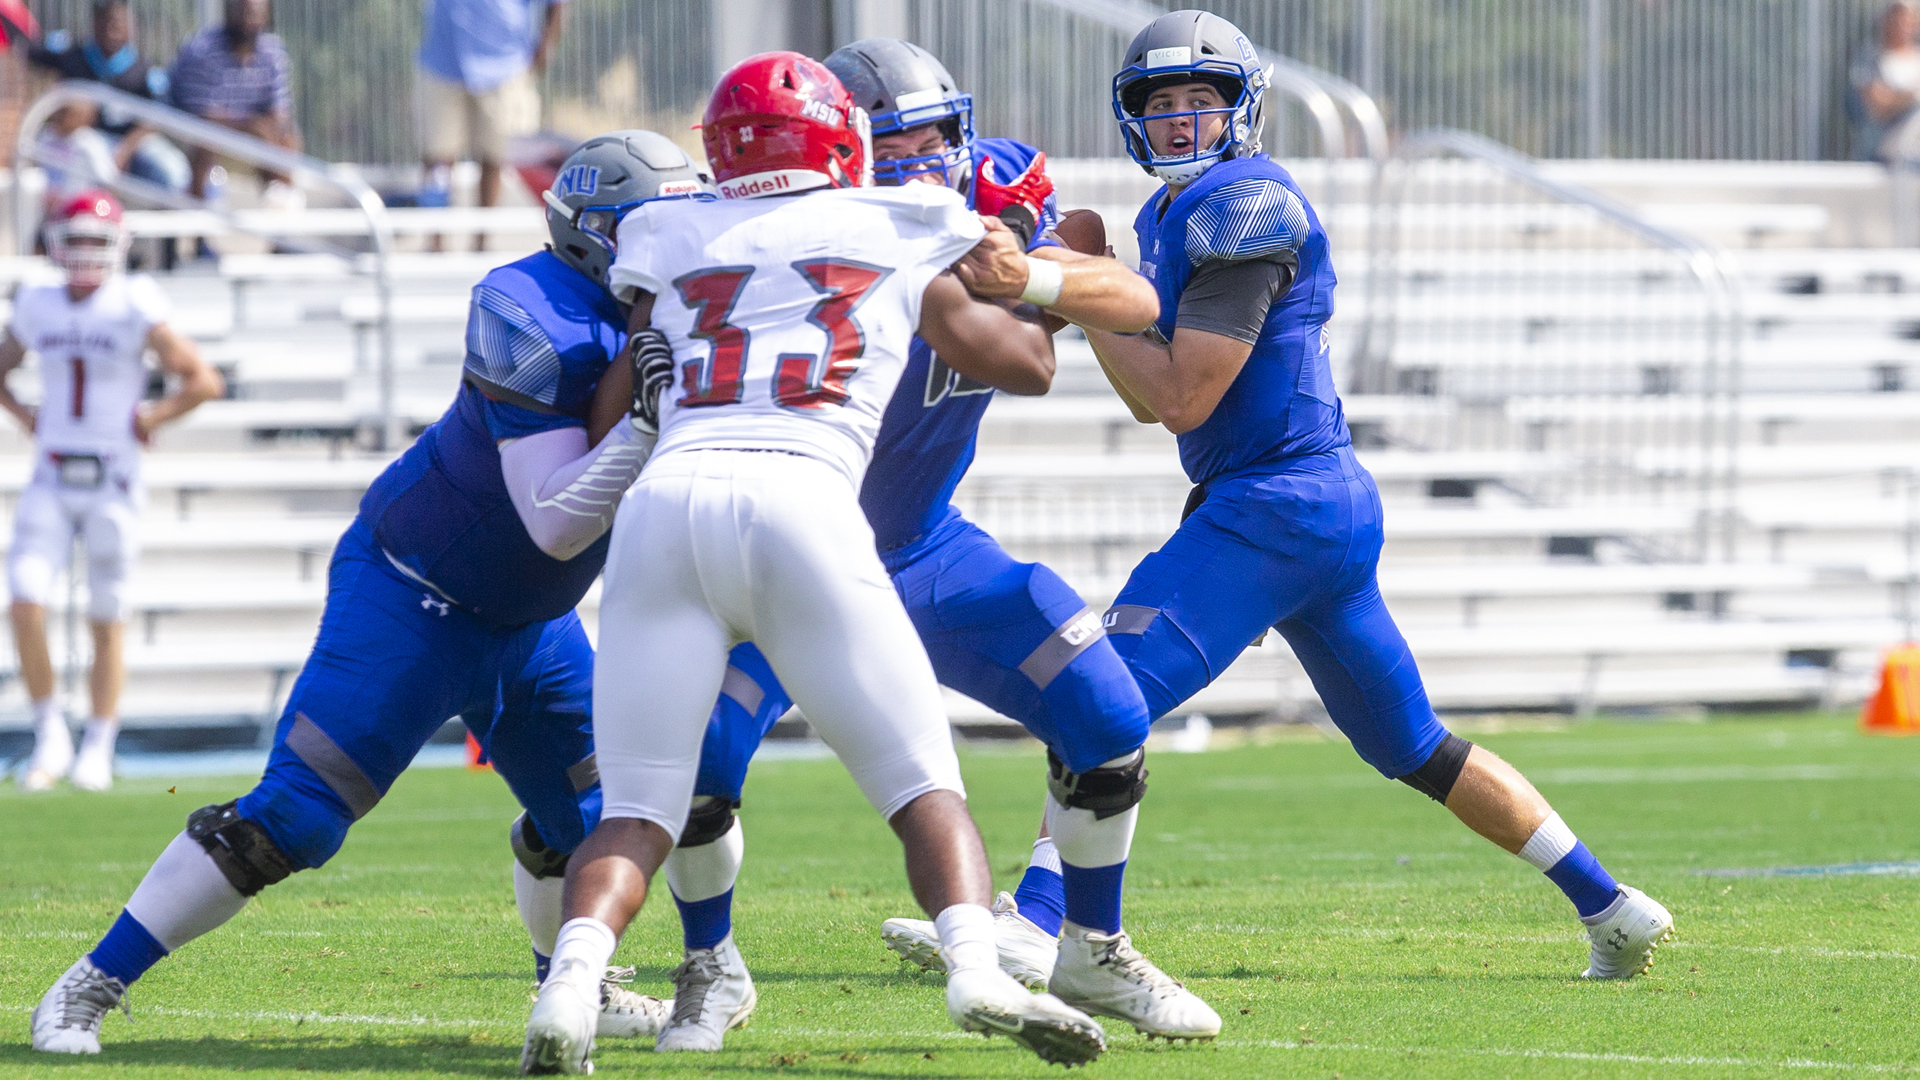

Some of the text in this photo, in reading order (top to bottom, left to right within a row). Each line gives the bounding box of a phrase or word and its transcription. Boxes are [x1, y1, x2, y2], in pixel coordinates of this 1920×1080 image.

[1154, 50, 1183, 60] VICIS
[1233, 34, 1257, 63] C
[801, 98, 841, 127] MSU
[721, 175, 789, 199] Riddell
[671, 257, 897, 414] 33
[70, 355, 86, 421] 1
